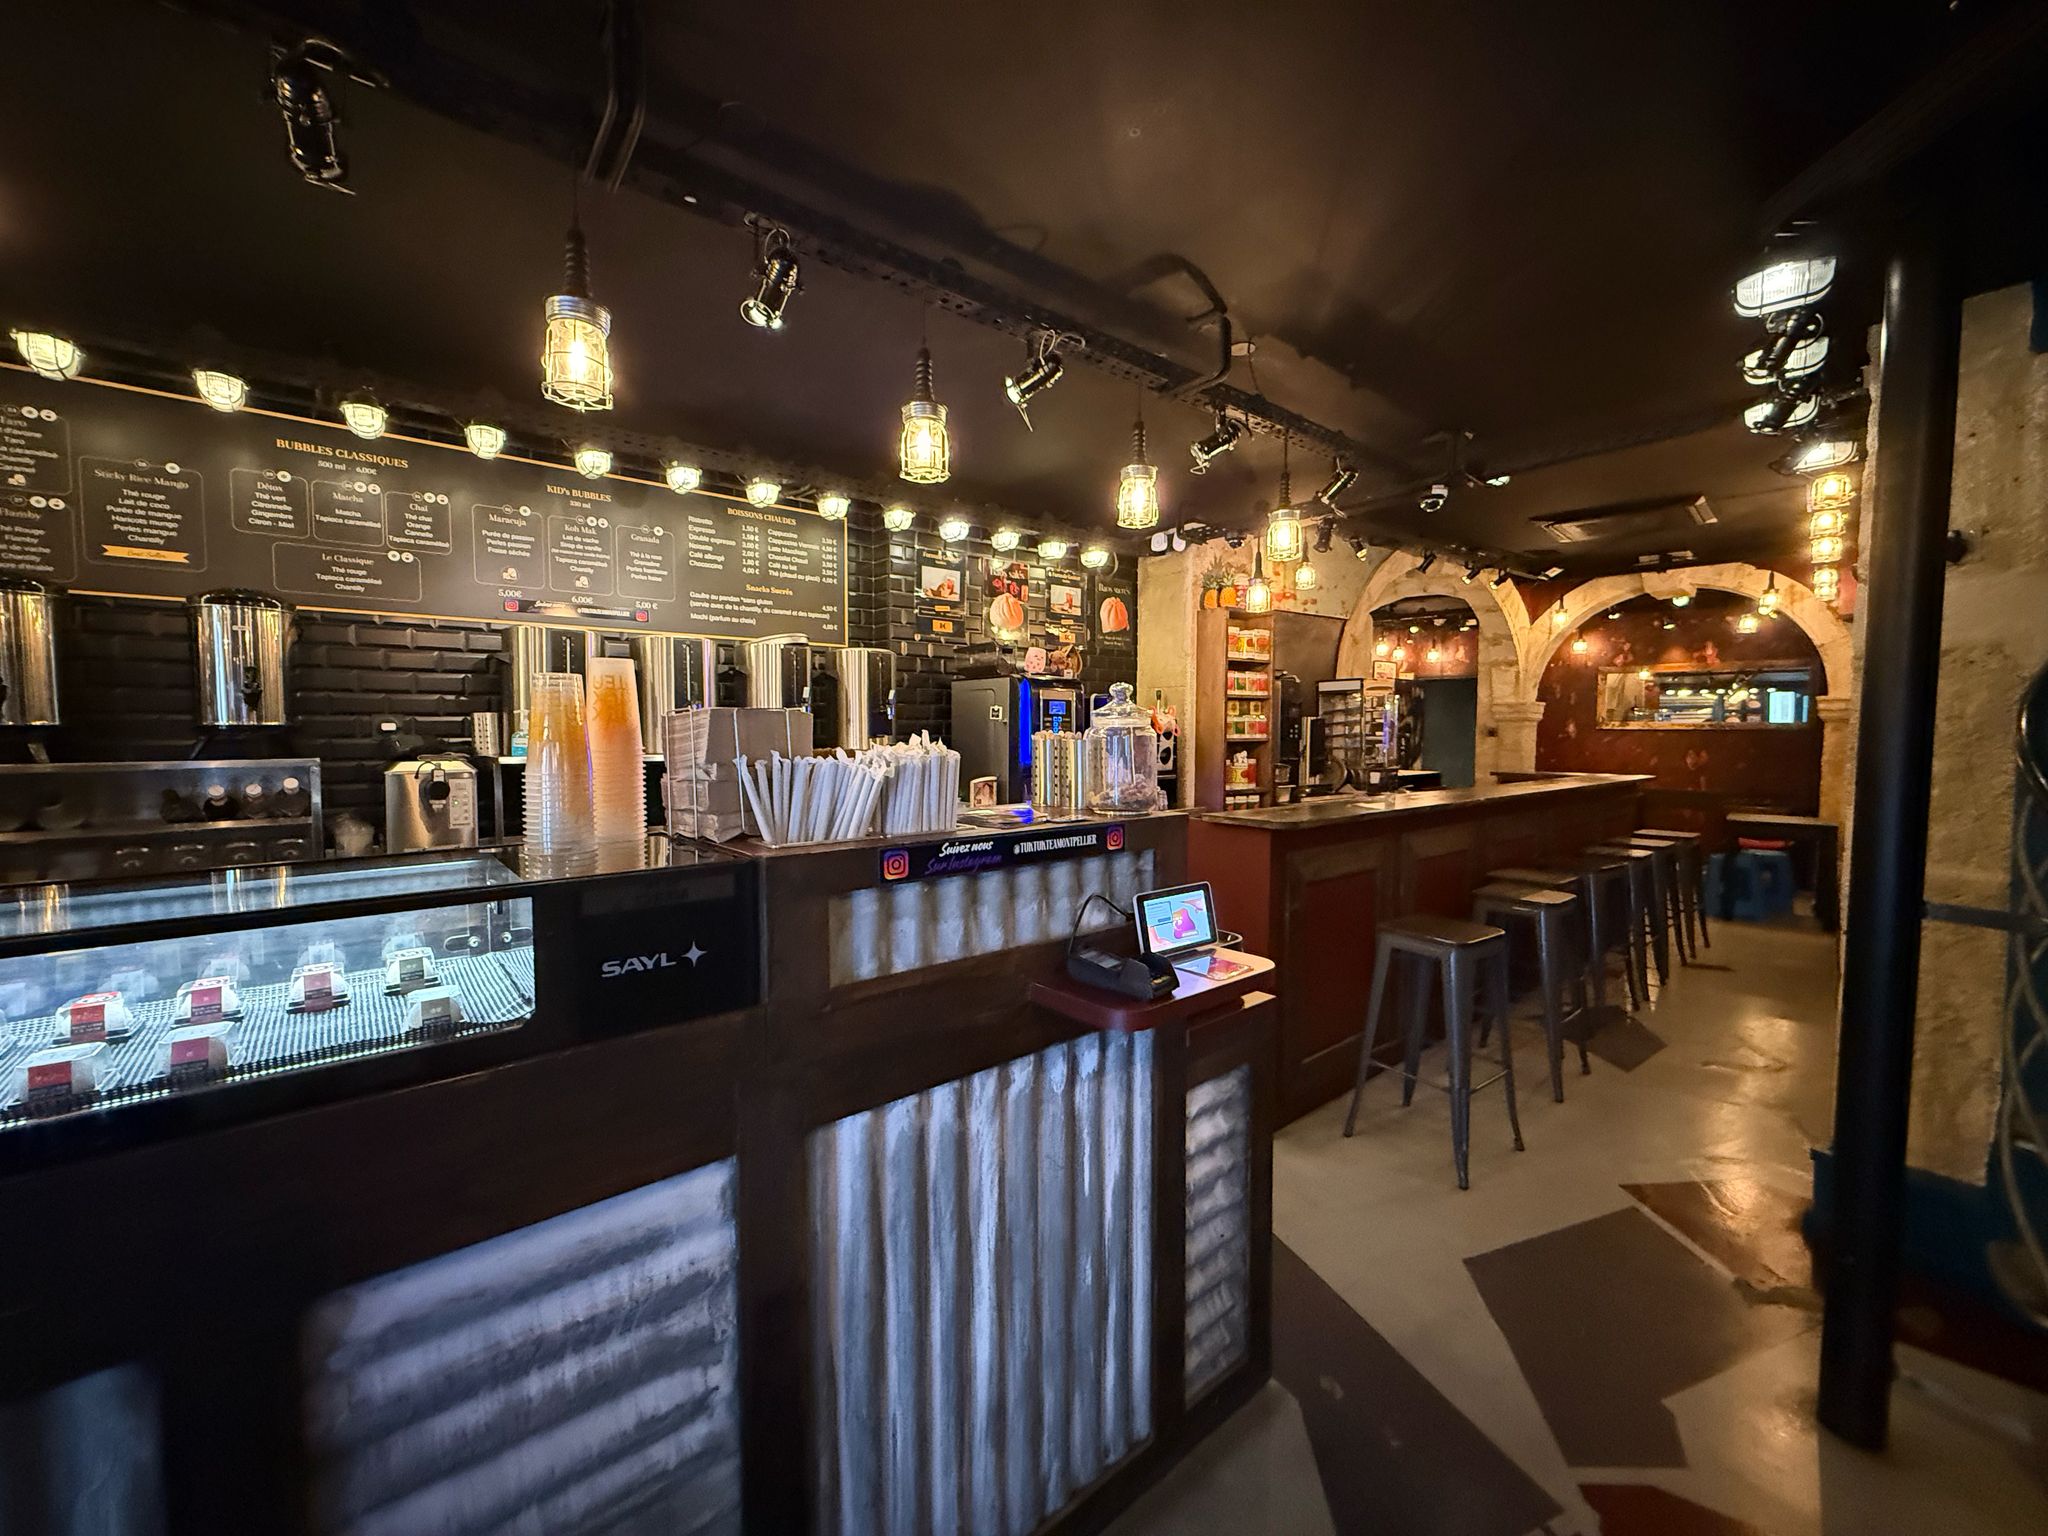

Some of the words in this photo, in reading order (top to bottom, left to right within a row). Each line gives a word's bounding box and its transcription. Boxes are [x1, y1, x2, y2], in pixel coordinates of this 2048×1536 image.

[276, 438, 333, 456] BUBBLES
[335, 448, 409, 469] CLASSIQUES
[318, 460, 333, 469] 500
[334, 462, 346, 471] ml
[94, 469, 125, 482] Sticky
[128, 474, 152, 484] Rice
[154, 477, 190, 490] Mango
[257, 481, 284, 492] Détox
[122, 488, 139, 497] Thé
[141, 492, 166, 501] rouge
[254, 491, 271, 500] Thé
[271, 494, 287, 503] vert
[332, 492, 364, 504] Matcha
[546, 484, 571, 496] KID's
[571, 488, 612, 503] BUBBLES
[118, 498, 135, 506] Lait
[136, 499, 148, 507] de
[149, 502, 171, 510] coco
[106, 505, 133, 515] Purée
[148, 510, 183, 520] mangue
[404, 513, 418, 521] Thé
[727, 507, 764, 521] BOISSONS
[763, 513, 797, 527] CHAUDES
[111, 514, 148, 525] Haricots
[149, 519, 179, 529] mungo
[247, 517, 272, 527] Citron
[278, 520, 295, 529] Miel
[406, 521, 431, 531] Orange
[488, 513, 528, 528] Maracuja
[113, 523, 142, 534] Perles
[143, 527, 178, 537] mangue
[481, 529, 502, 538] Purée
[127, 534, 165, 545] Chantilly
[486, 538, 507, 547] Perles
[321, 552, 333, 562] Le
[334, 554, 375, 567] Classique
[331, 566, 346, 574] Thé
[346, 568, 368, 577] rouge
[745, 583, 771, 594] Snacks
[939, 842, 970, 857] Suivez
[971, 841, 994, 852] nous
[602, 953, 676, 977] SAYL
